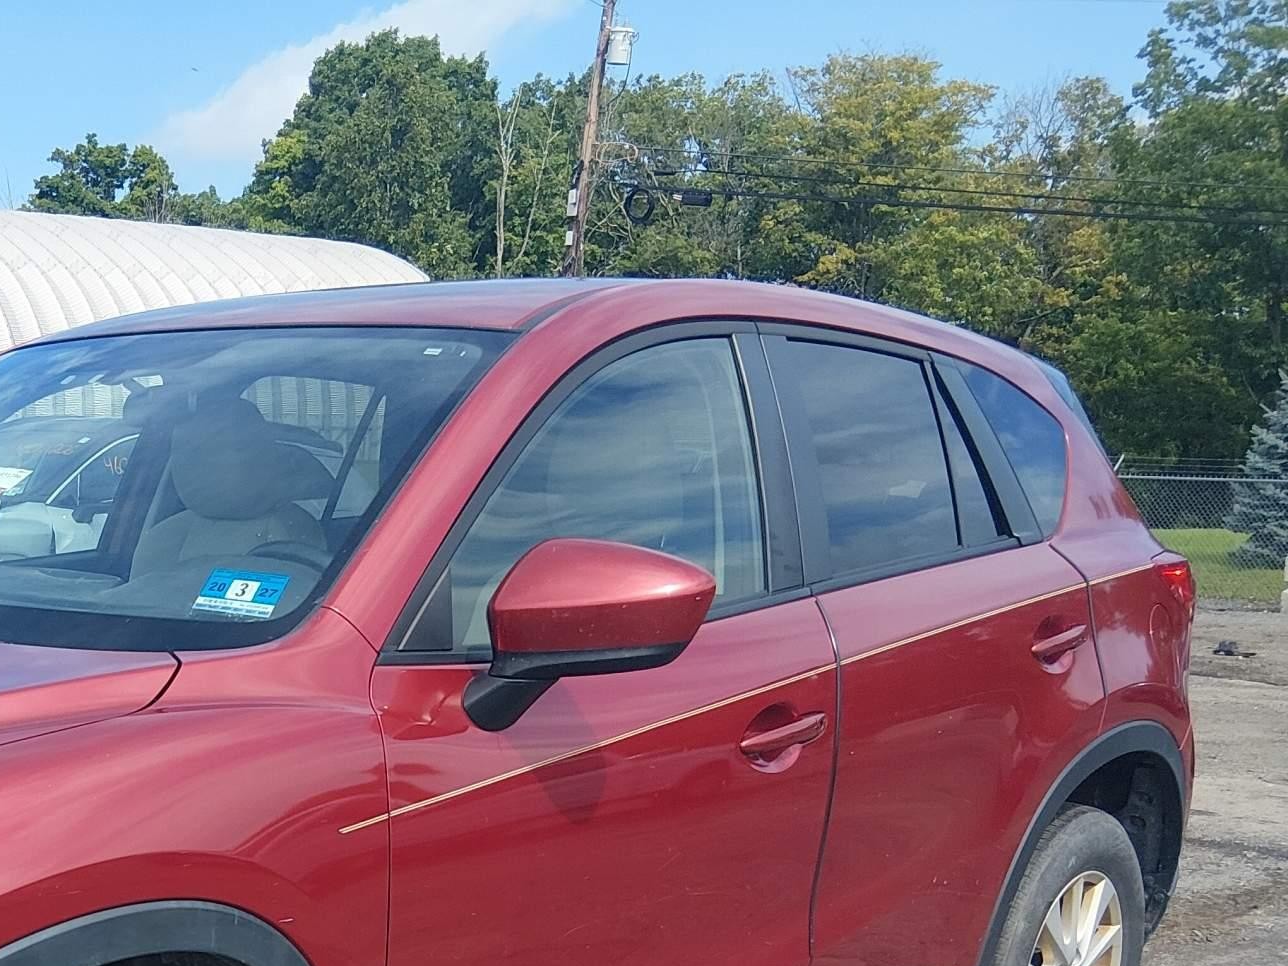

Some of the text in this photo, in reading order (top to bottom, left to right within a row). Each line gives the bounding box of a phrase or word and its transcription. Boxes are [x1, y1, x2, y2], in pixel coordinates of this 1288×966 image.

[208, 581, 278, 598] 20 3 27
